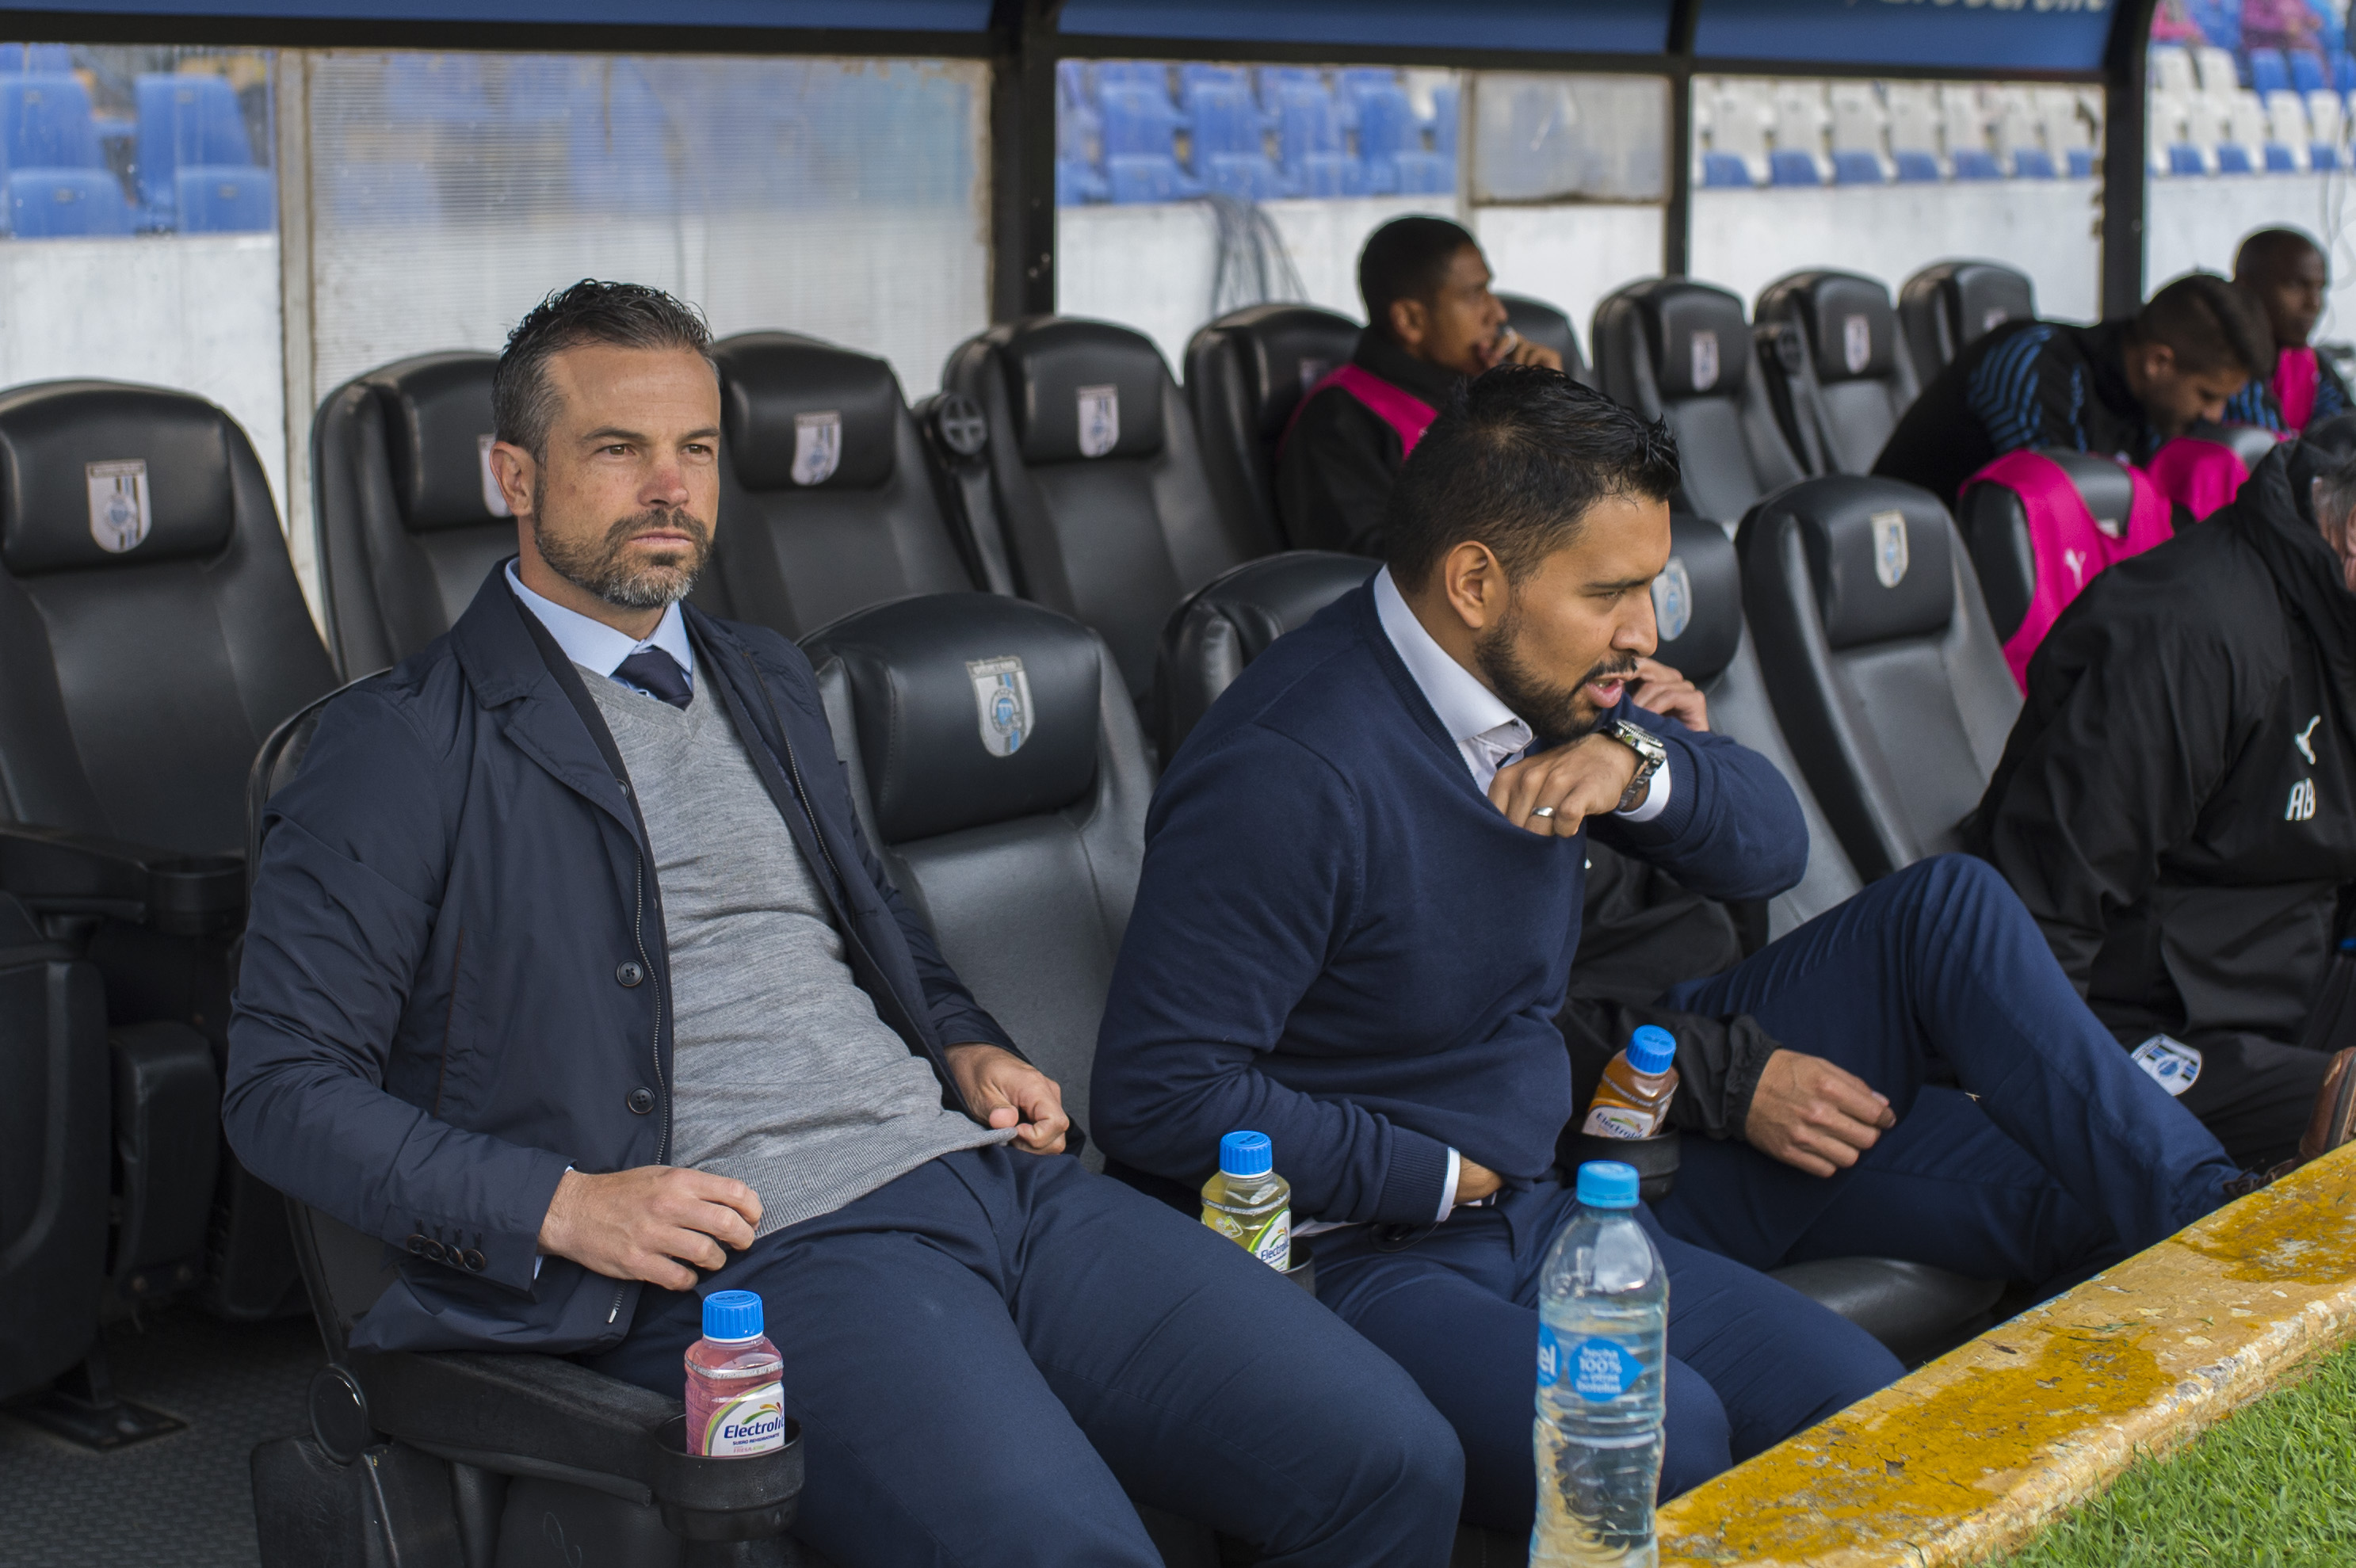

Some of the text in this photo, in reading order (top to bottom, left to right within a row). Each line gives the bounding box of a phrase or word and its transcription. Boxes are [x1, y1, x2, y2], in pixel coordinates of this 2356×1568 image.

[2285, 777, 2316, 820] AB
[1579, 1356, 1622, 1373] 100%
[724, 1415, 784, 1439] Electrolit
